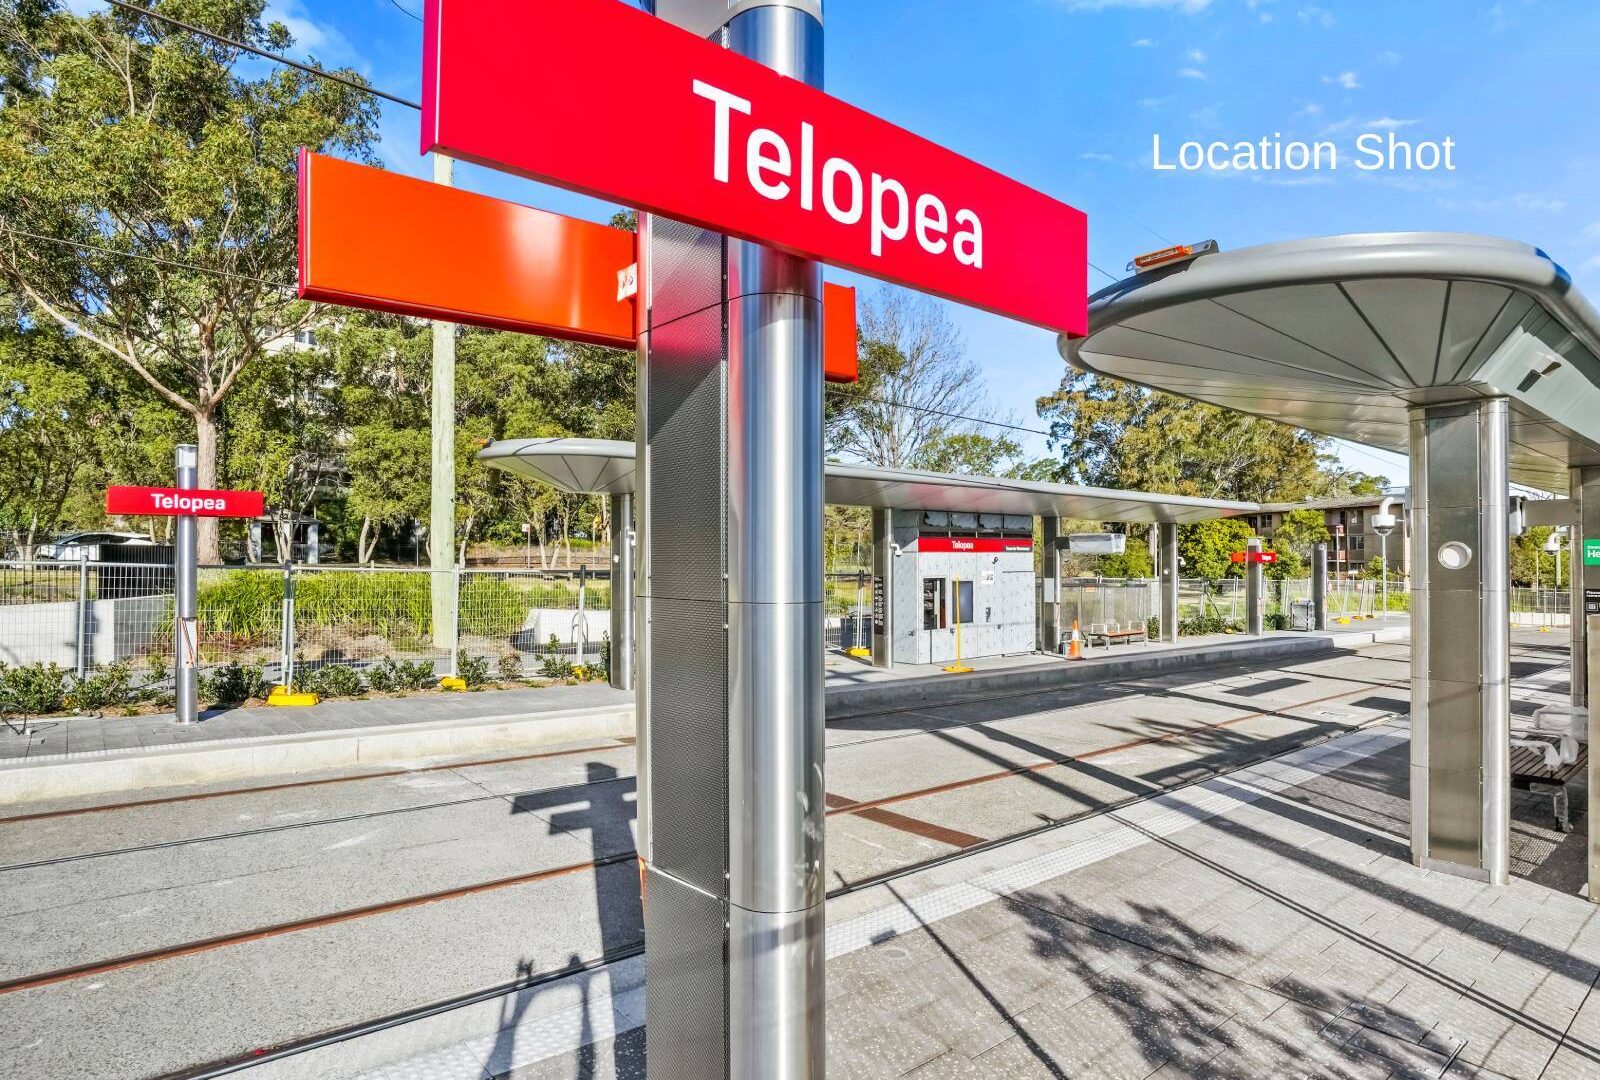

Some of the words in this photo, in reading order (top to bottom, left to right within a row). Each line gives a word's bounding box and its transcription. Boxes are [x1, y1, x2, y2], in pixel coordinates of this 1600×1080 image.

[692, 78, 983, 269] Telopea
[150, 493, 226, 512] Telopea
[951, 540, 974, 551] Telopea
